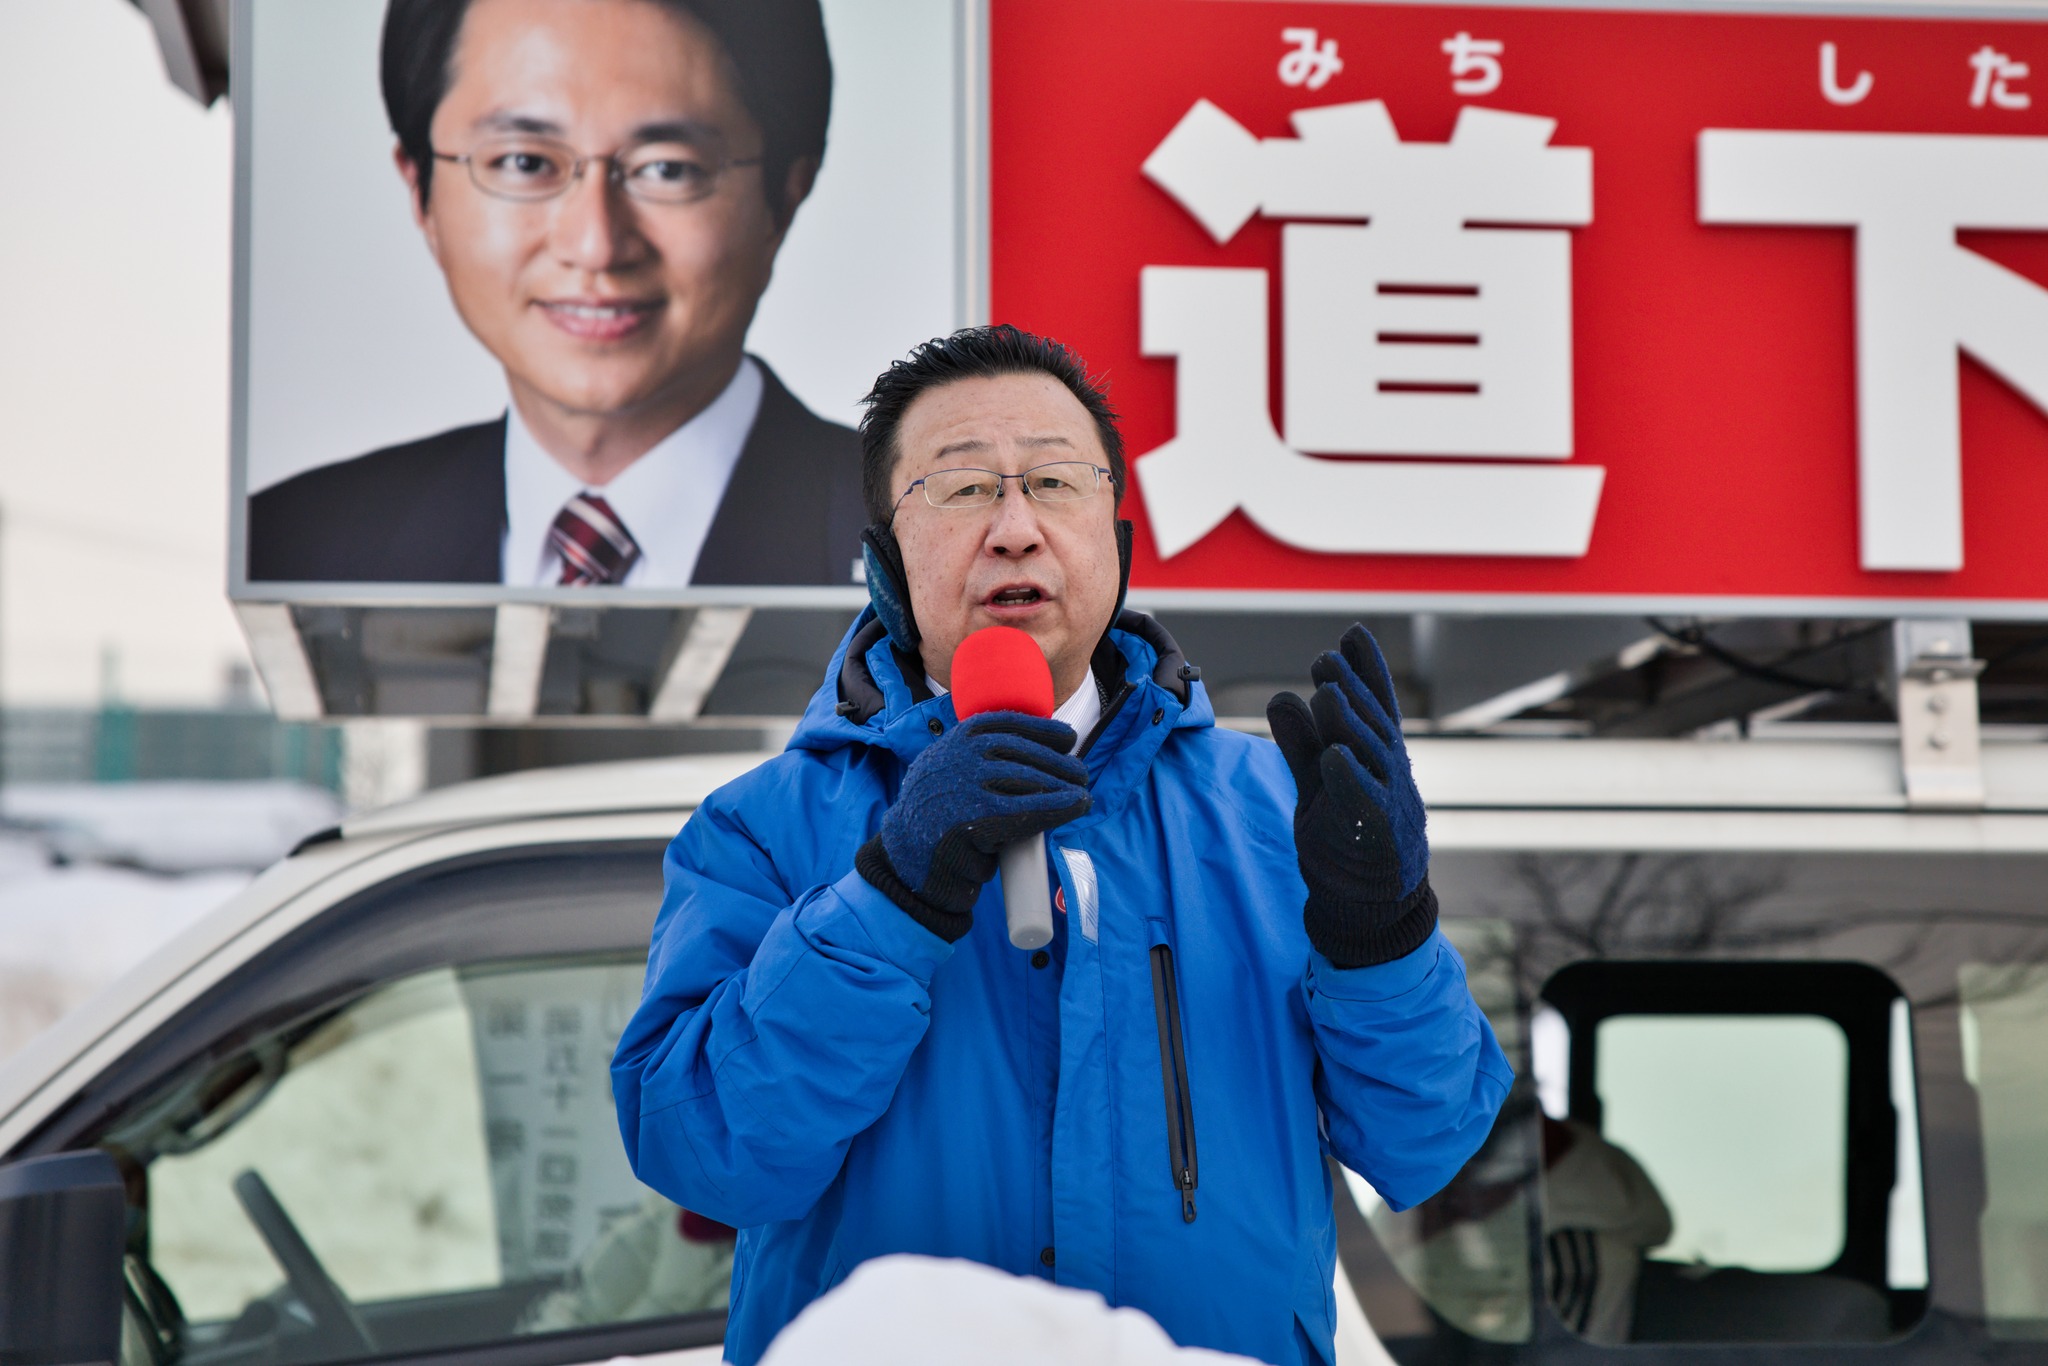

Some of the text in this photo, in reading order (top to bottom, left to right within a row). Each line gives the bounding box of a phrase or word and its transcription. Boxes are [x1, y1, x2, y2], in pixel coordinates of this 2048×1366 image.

[1278, 28, 2031, 109] みち した
[1135, 99, 2048, 571] 道下
